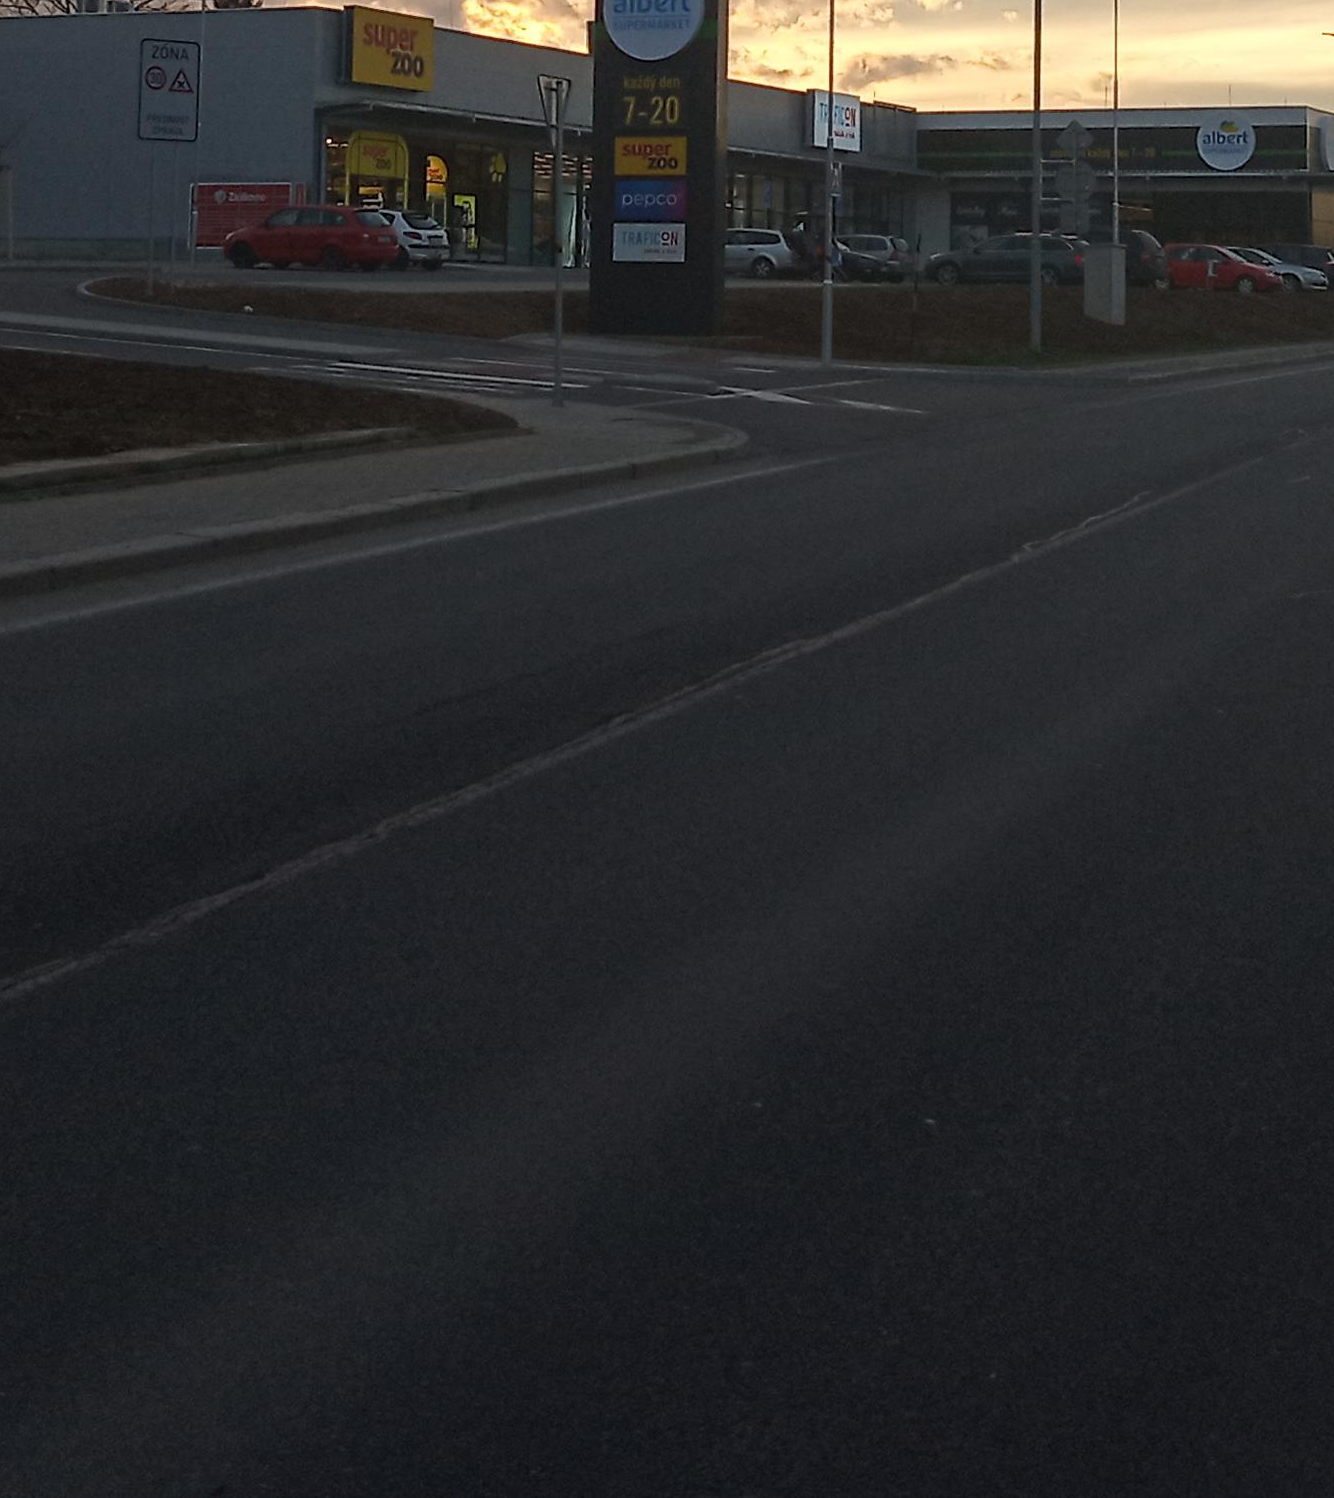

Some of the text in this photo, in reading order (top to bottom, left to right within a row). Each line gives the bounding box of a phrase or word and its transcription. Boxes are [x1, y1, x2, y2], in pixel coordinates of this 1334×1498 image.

[614, 19, 690, 30] SUPERMARKET
[363, 23, 418, 54] super
[623, 75, 681, 91] každý den
[820, 103, 857, 127] TRFICON
[1202, 130, 1248, 144] albert
[623, 144, 672, 159] super
[622, 193, 678, 209] pepco
[622, 231, 678, 247] TRAFICON
